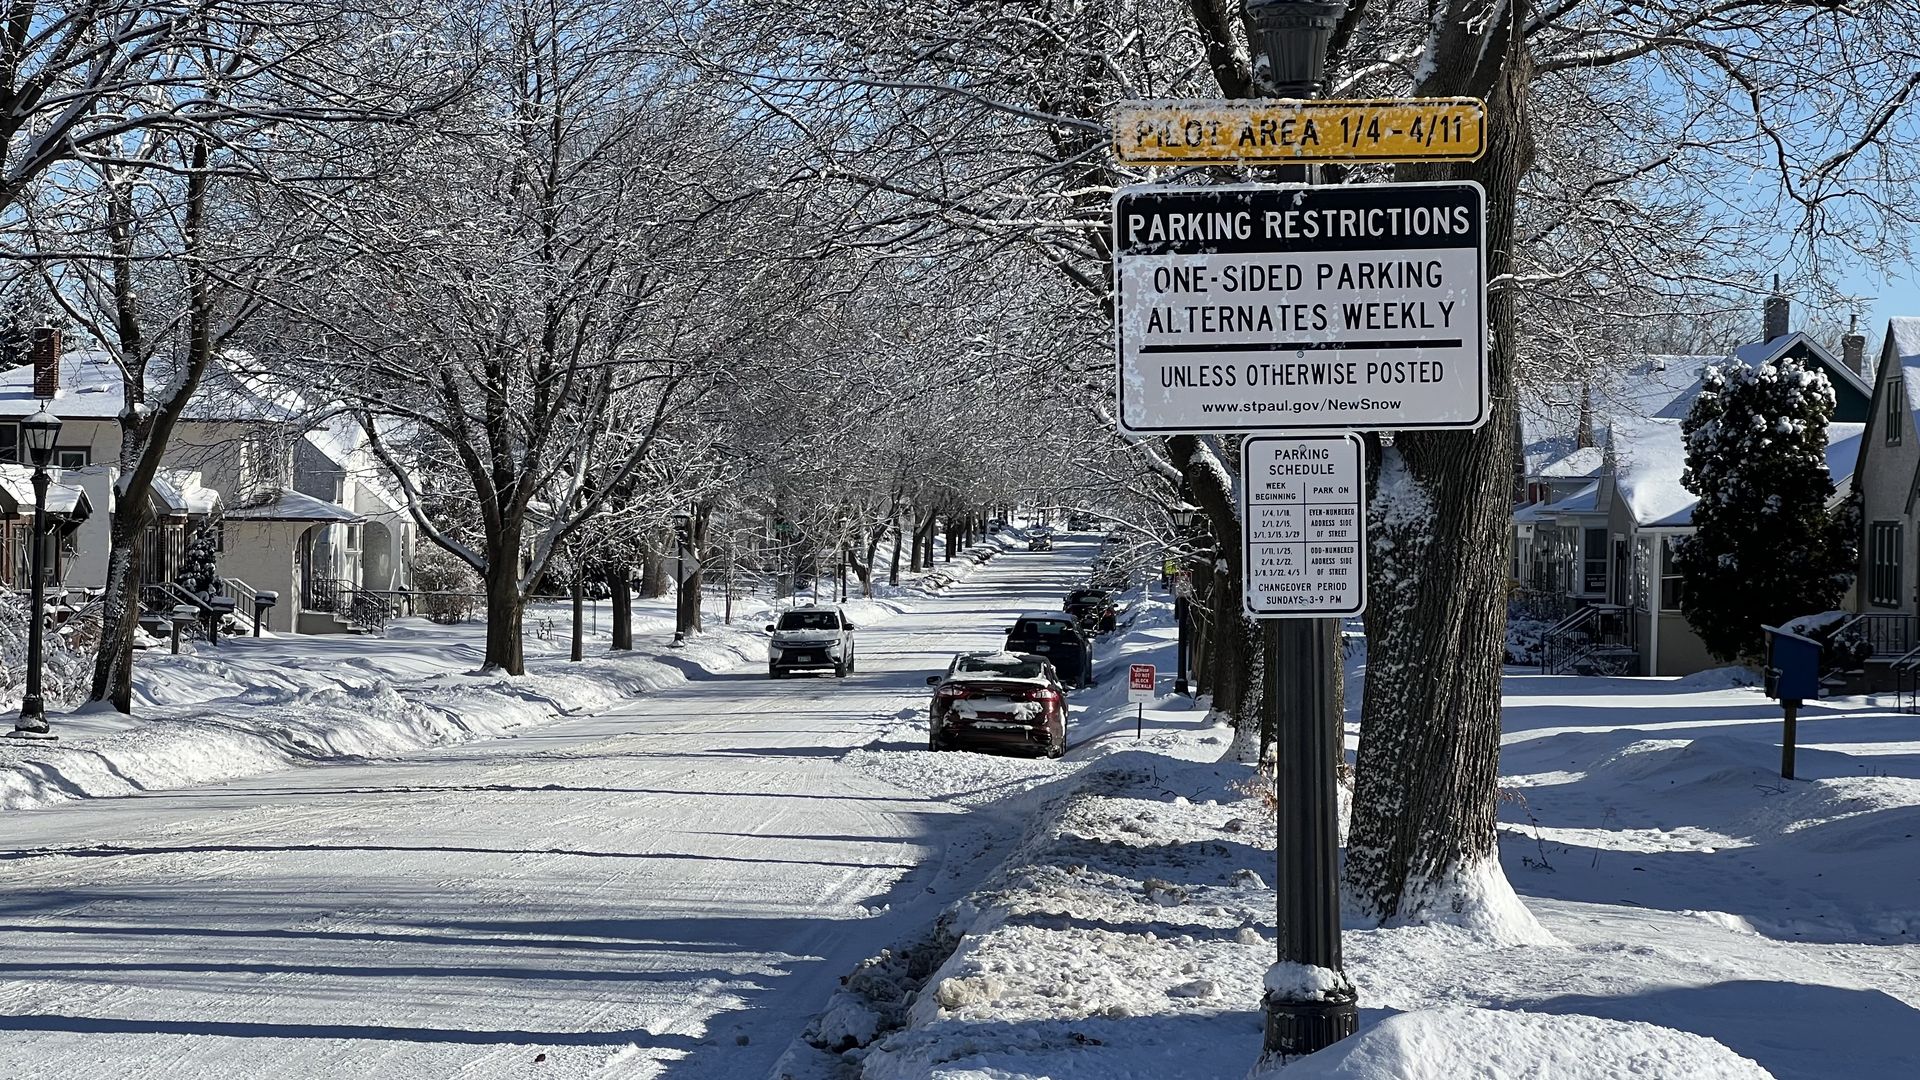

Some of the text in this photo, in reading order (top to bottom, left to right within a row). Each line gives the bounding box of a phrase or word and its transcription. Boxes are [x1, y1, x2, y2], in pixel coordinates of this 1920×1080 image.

[1136, 120, 1221, 147] PILOT
[1239, 117, 1320, 147] AREA
[1128, 207, 1470, 242] PARKING RESTRICTIONS
[1153, 260, 1443, 294] ONE-SIDED PARKING
[1147, 301, 1455, 334] ALTERNATES WEEKLY
[1161, 361, 1444, 388] UNLESS OTHERWISE POSTED
[1202, 398, 1402, 414] www.stpaul.gov/NewSnow
[1275, 448, 1329, 460] PARKING
[1269, 463, 1335, 475] SCHEDULE
[1266, 482, 1286, 490] WEEK
[1313, 486, 1349, 494] PARK ON
[1255, 493, 1296, 501] BEGINNING
[1309, 508, 1355, 516] EVEN-NUMBERED
[1311, 519, 1352, 527] ADDRESS SIDE
[1316, 530, 1347, 538] OF STREET
[1311, 546, 1354, 554] ODD-NUMBERED
[1311, 557, 1352, 565] ADDRESS SIDE
[1316, 568, 1347, 576] OF STREET
[1258, 582, 1347, 592] CHANGEOVER PERIOD
[1266, 595, 1342, 605] SUNDAYS 3-9 PM
